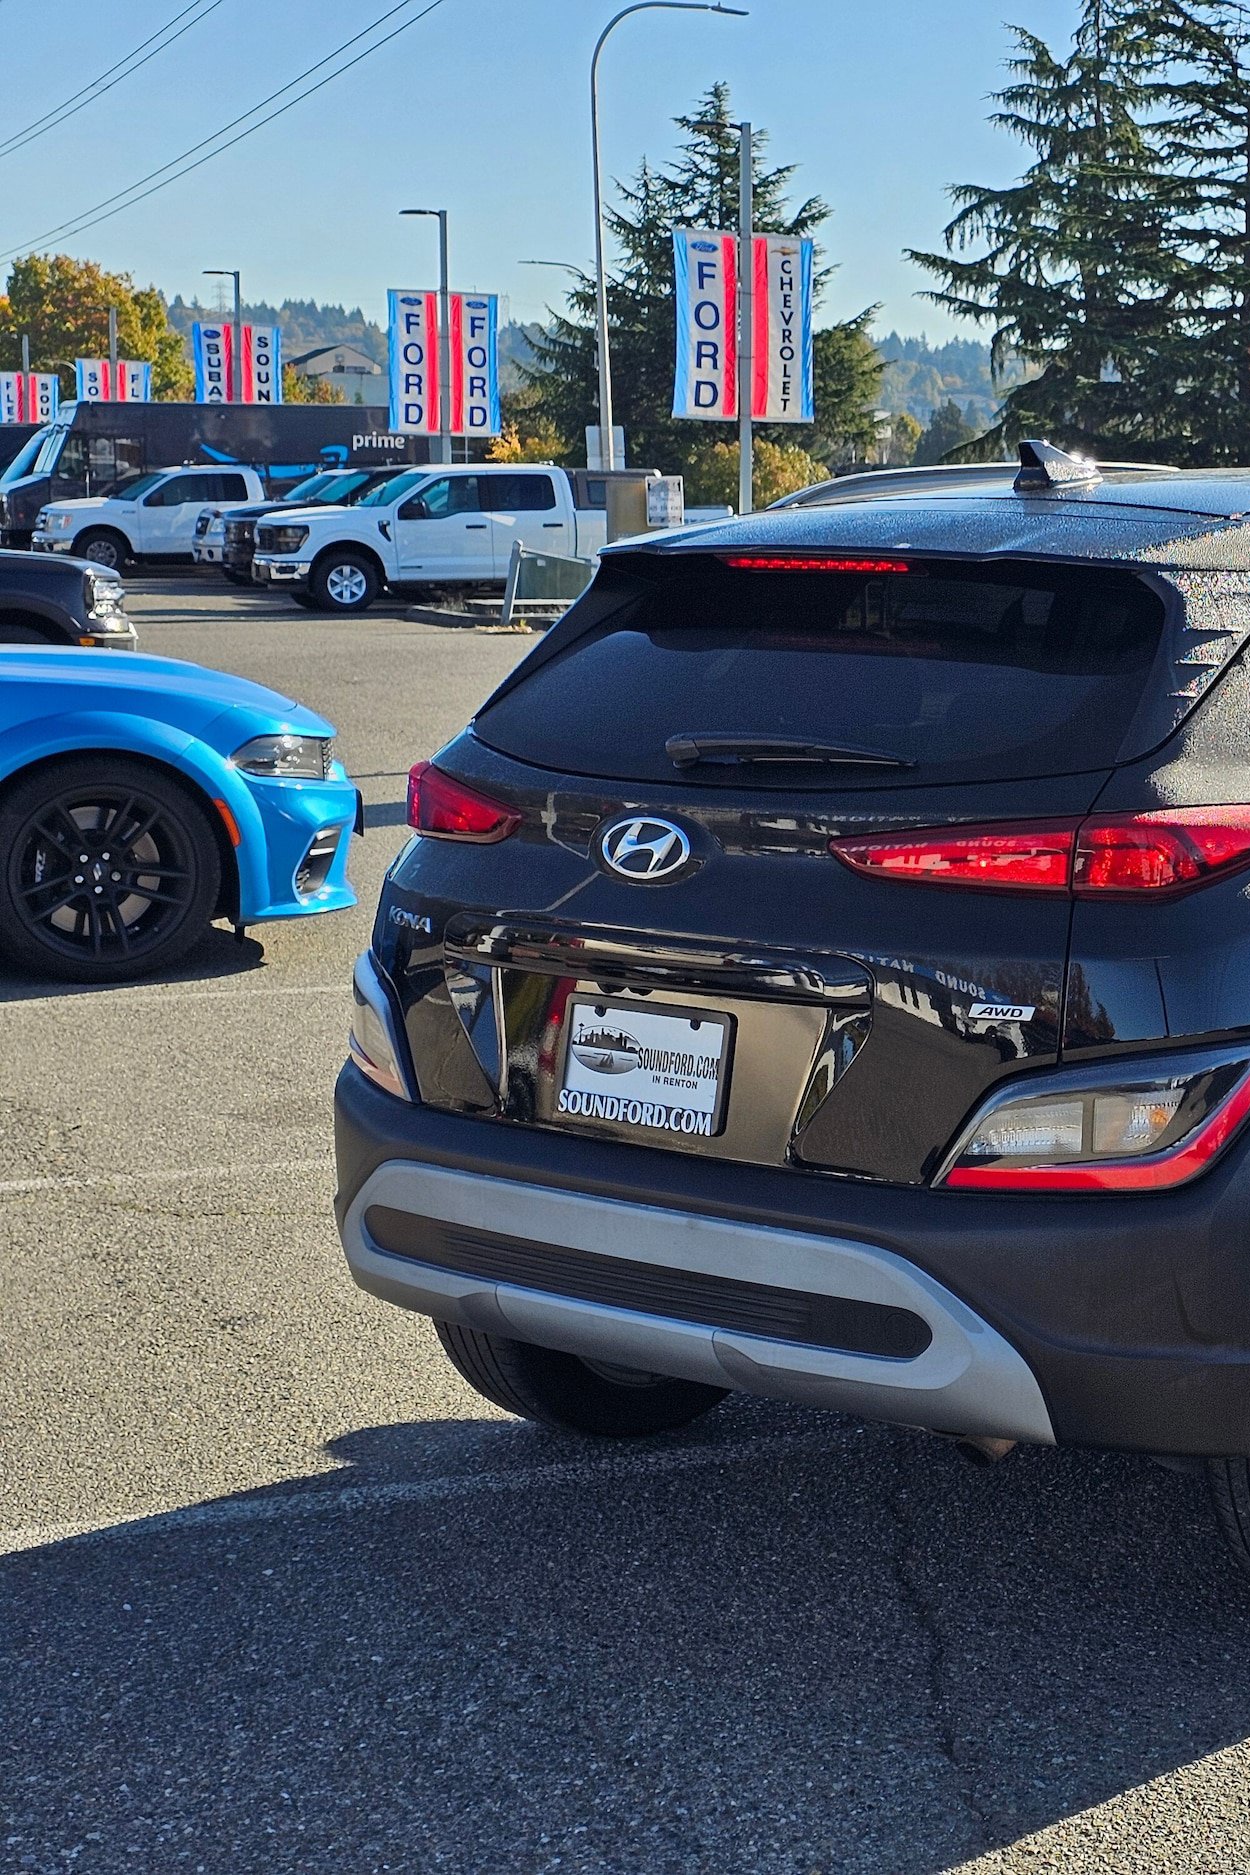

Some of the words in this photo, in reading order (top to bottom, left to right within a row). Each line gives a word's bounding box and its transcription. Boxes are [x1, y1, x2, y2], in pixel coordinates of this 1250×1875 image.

[694, 261, 720, 409] FORD
[778, 259, 795, 412] CHEVROLET
[206, 343, 222, 403] SUBA
[403, 313, 424, 425] FORD
[467, 316, 488, 427] FORD
[6, 381, 14, 423] FLE
[352, 430, 406, 452] prime
[389, 905, 431, 934] KONA
[977, 1006, 1024, 1018] AWD
[637, 1047, 720, 1081] SOUNDFORD.COM
[652, 1075, 661, 1084] IN
[663, 1076, 698, 1090] RENTON
[557, 1089, 712, 1137] SOUNDFORD.COM
